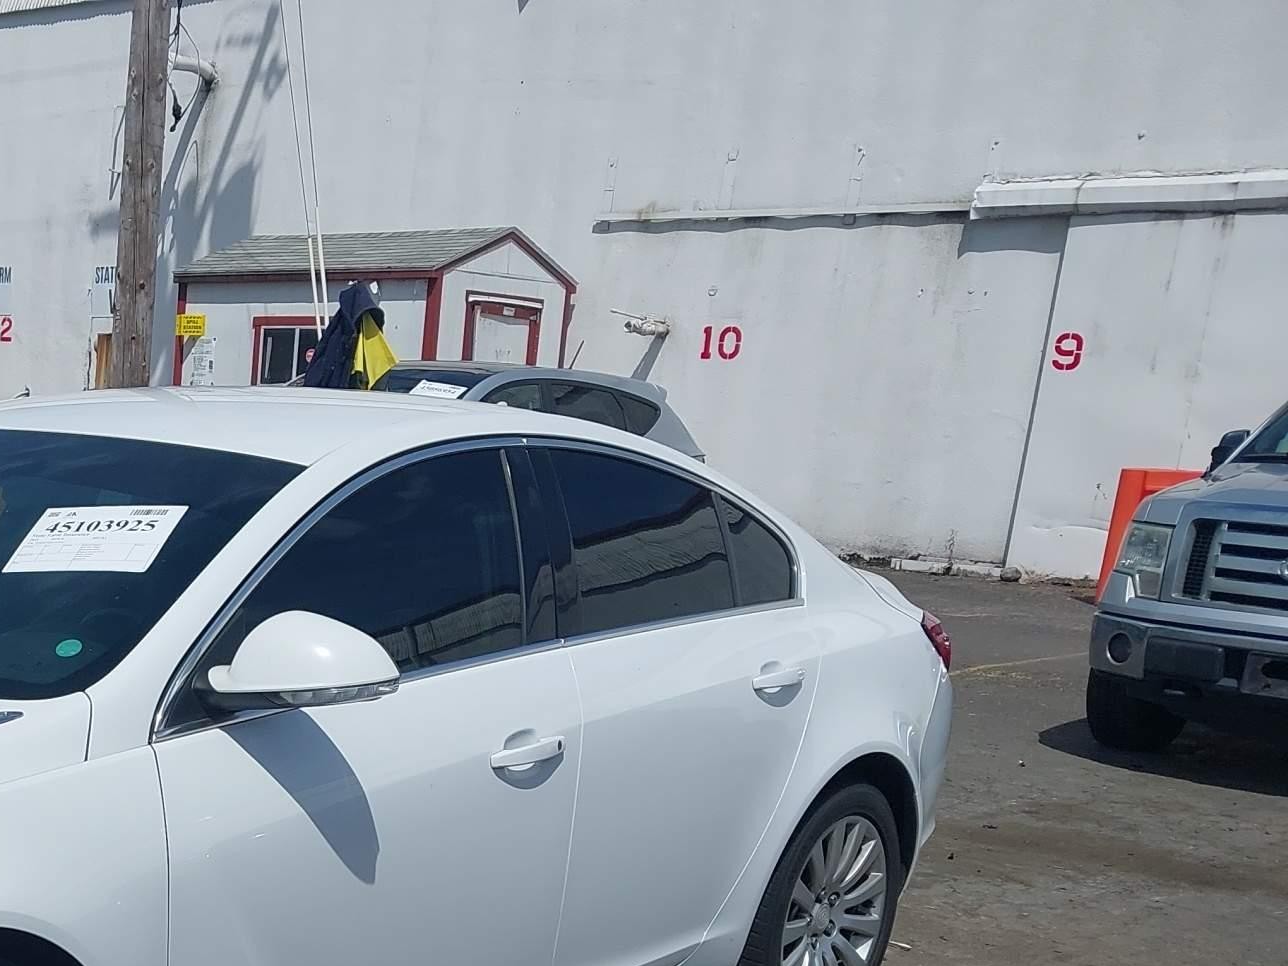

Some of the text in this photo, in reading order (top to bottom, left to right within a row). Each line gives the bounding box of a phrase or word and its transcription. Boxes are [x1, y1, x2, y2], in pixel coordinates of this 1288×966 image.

[95, 266, 115, 284] STAT
[700, 325, 743, 360] 10
[1051, 332, 1084, 371] 9
[45, 519, 160, 534] 45103925
